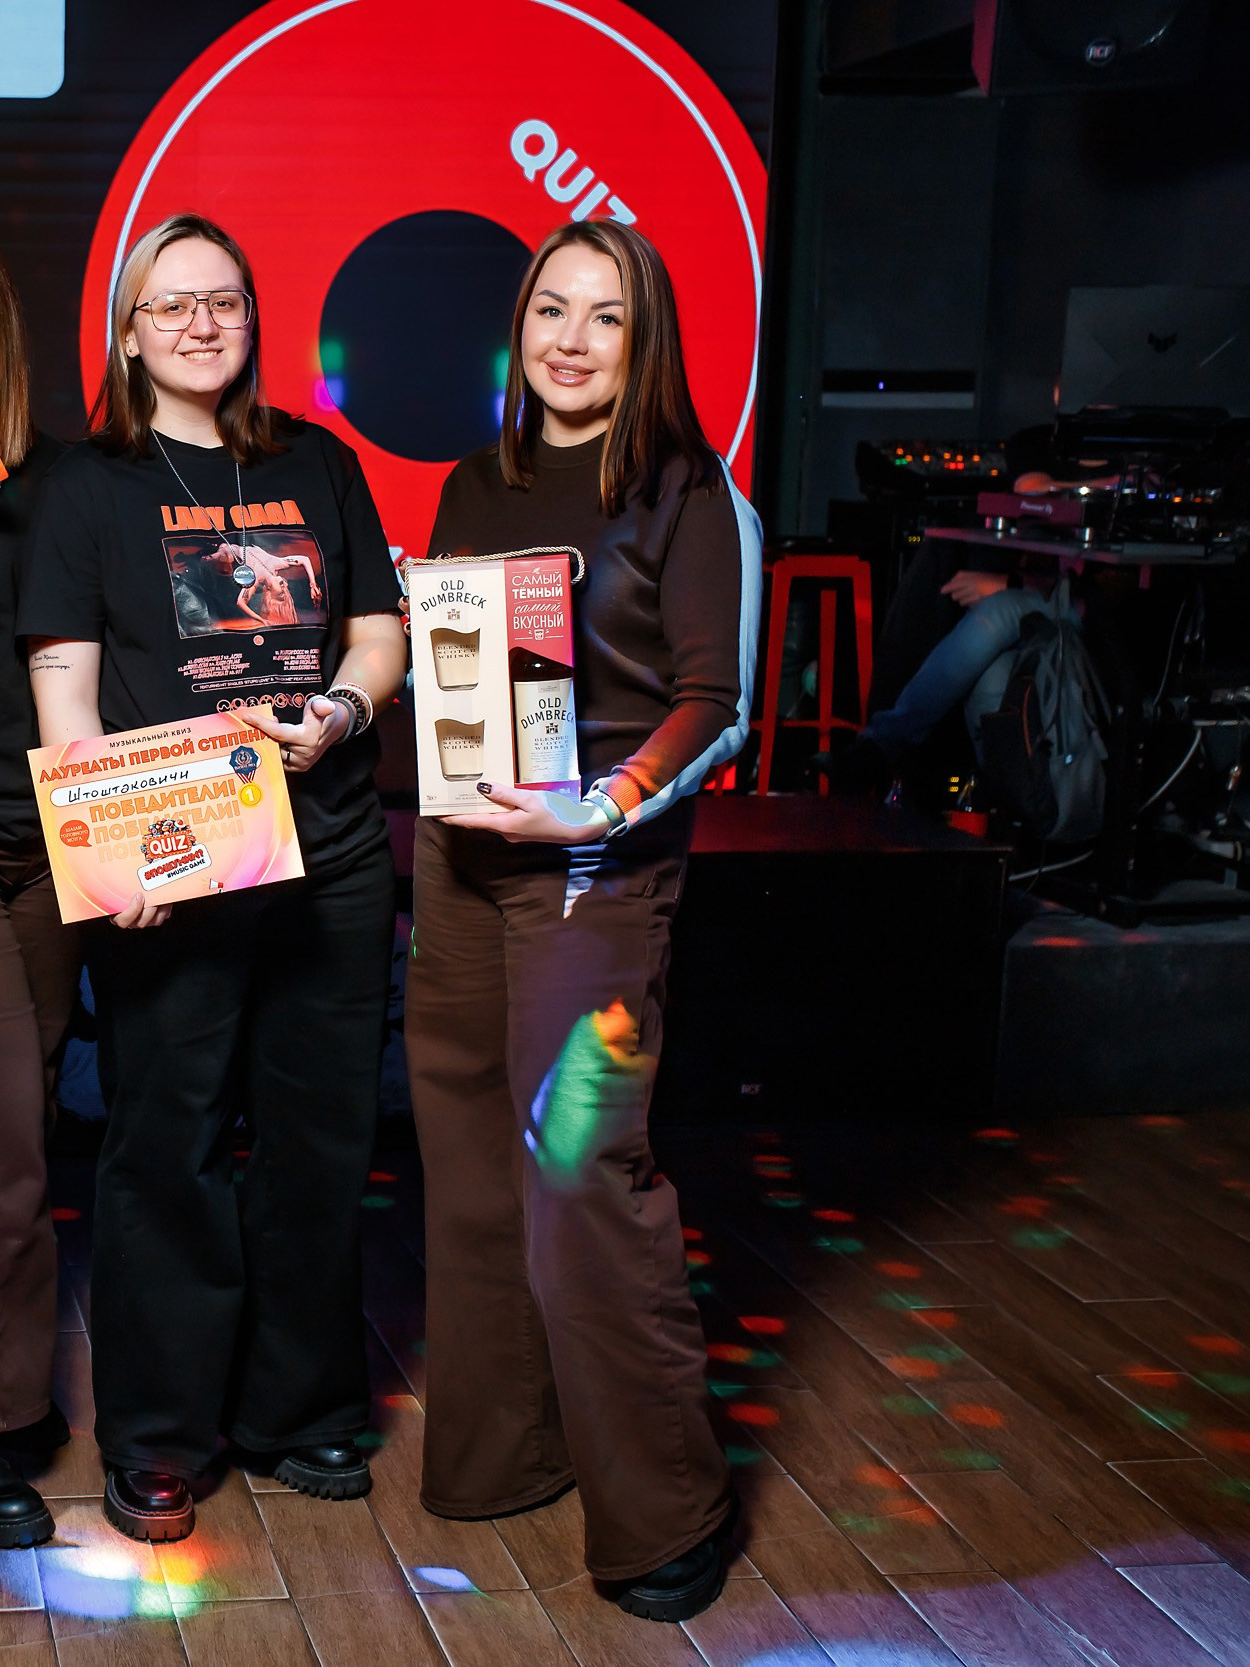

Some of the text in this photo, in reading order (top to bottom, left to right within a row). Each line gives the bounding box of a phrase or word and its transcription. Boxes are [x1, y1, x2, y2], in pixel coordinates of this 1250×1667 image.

[160, 500, 306, 531] LADY GAGA
[440, 580, 464, 592] OLD
[512, 572, 562, 586] САМЫЙ
[512, 584, 563, 599] ТЁМНЫЙ
[420, 592, 487, 612] DUMBRECK
[514, 602, 561, 614] самый
[513, 612, 564, 629] ВКУСНЫЙ
[538, 697, 562, 709] OLD
[109, 727, 192, 748] МУЗЫКАЛЬНЫЙ КВИЗ
[39, 754, 126, 784] ЛАУРЕАТЫ
[128, 738, 195, 766] ПЕРВОЙ
[89, 778, 237, 823] ПОБЕДИТЕЛИ!
[245, 788, 255, 802] 1
[150, 834, 188, 855] QUIZ
[167, 858, 206, 879] #MUSIC GAME
